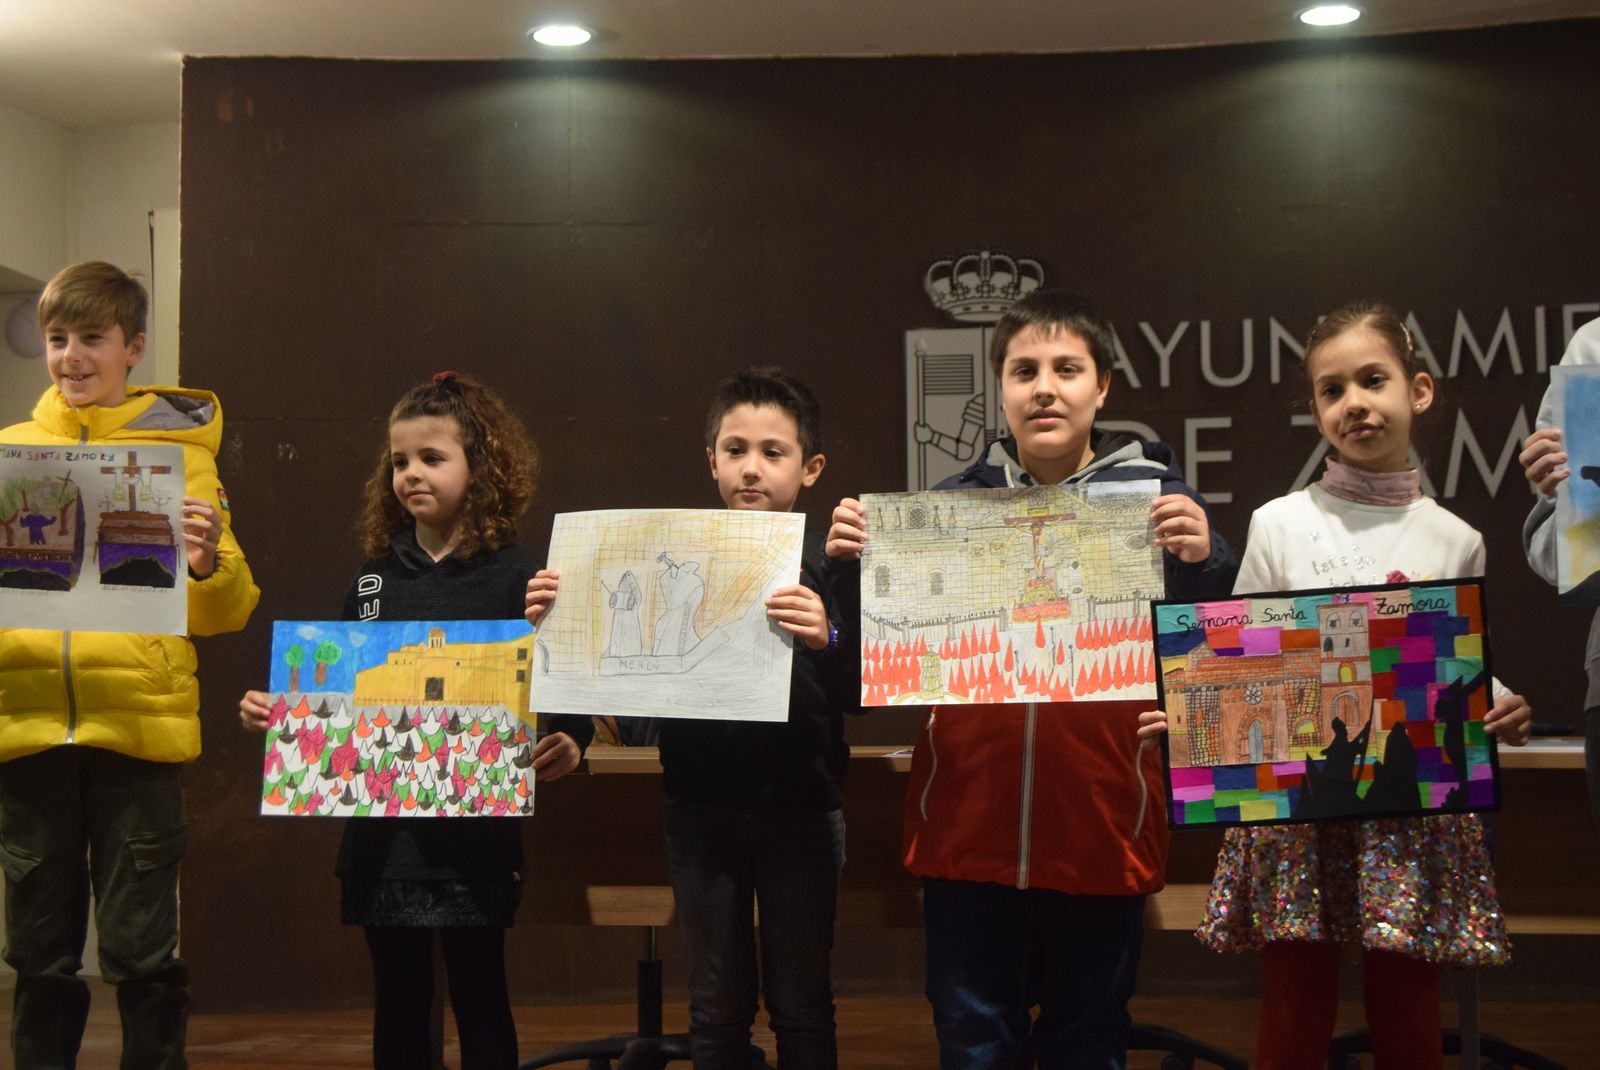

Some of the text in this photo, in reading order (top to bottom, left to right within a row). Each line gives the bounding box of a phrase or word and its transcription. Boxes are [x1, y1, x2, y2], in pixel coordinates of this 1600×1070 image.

[27, 450, 60, 461] SANTA
[1177, 596, 1450, 637] Semana Santa Zamora
